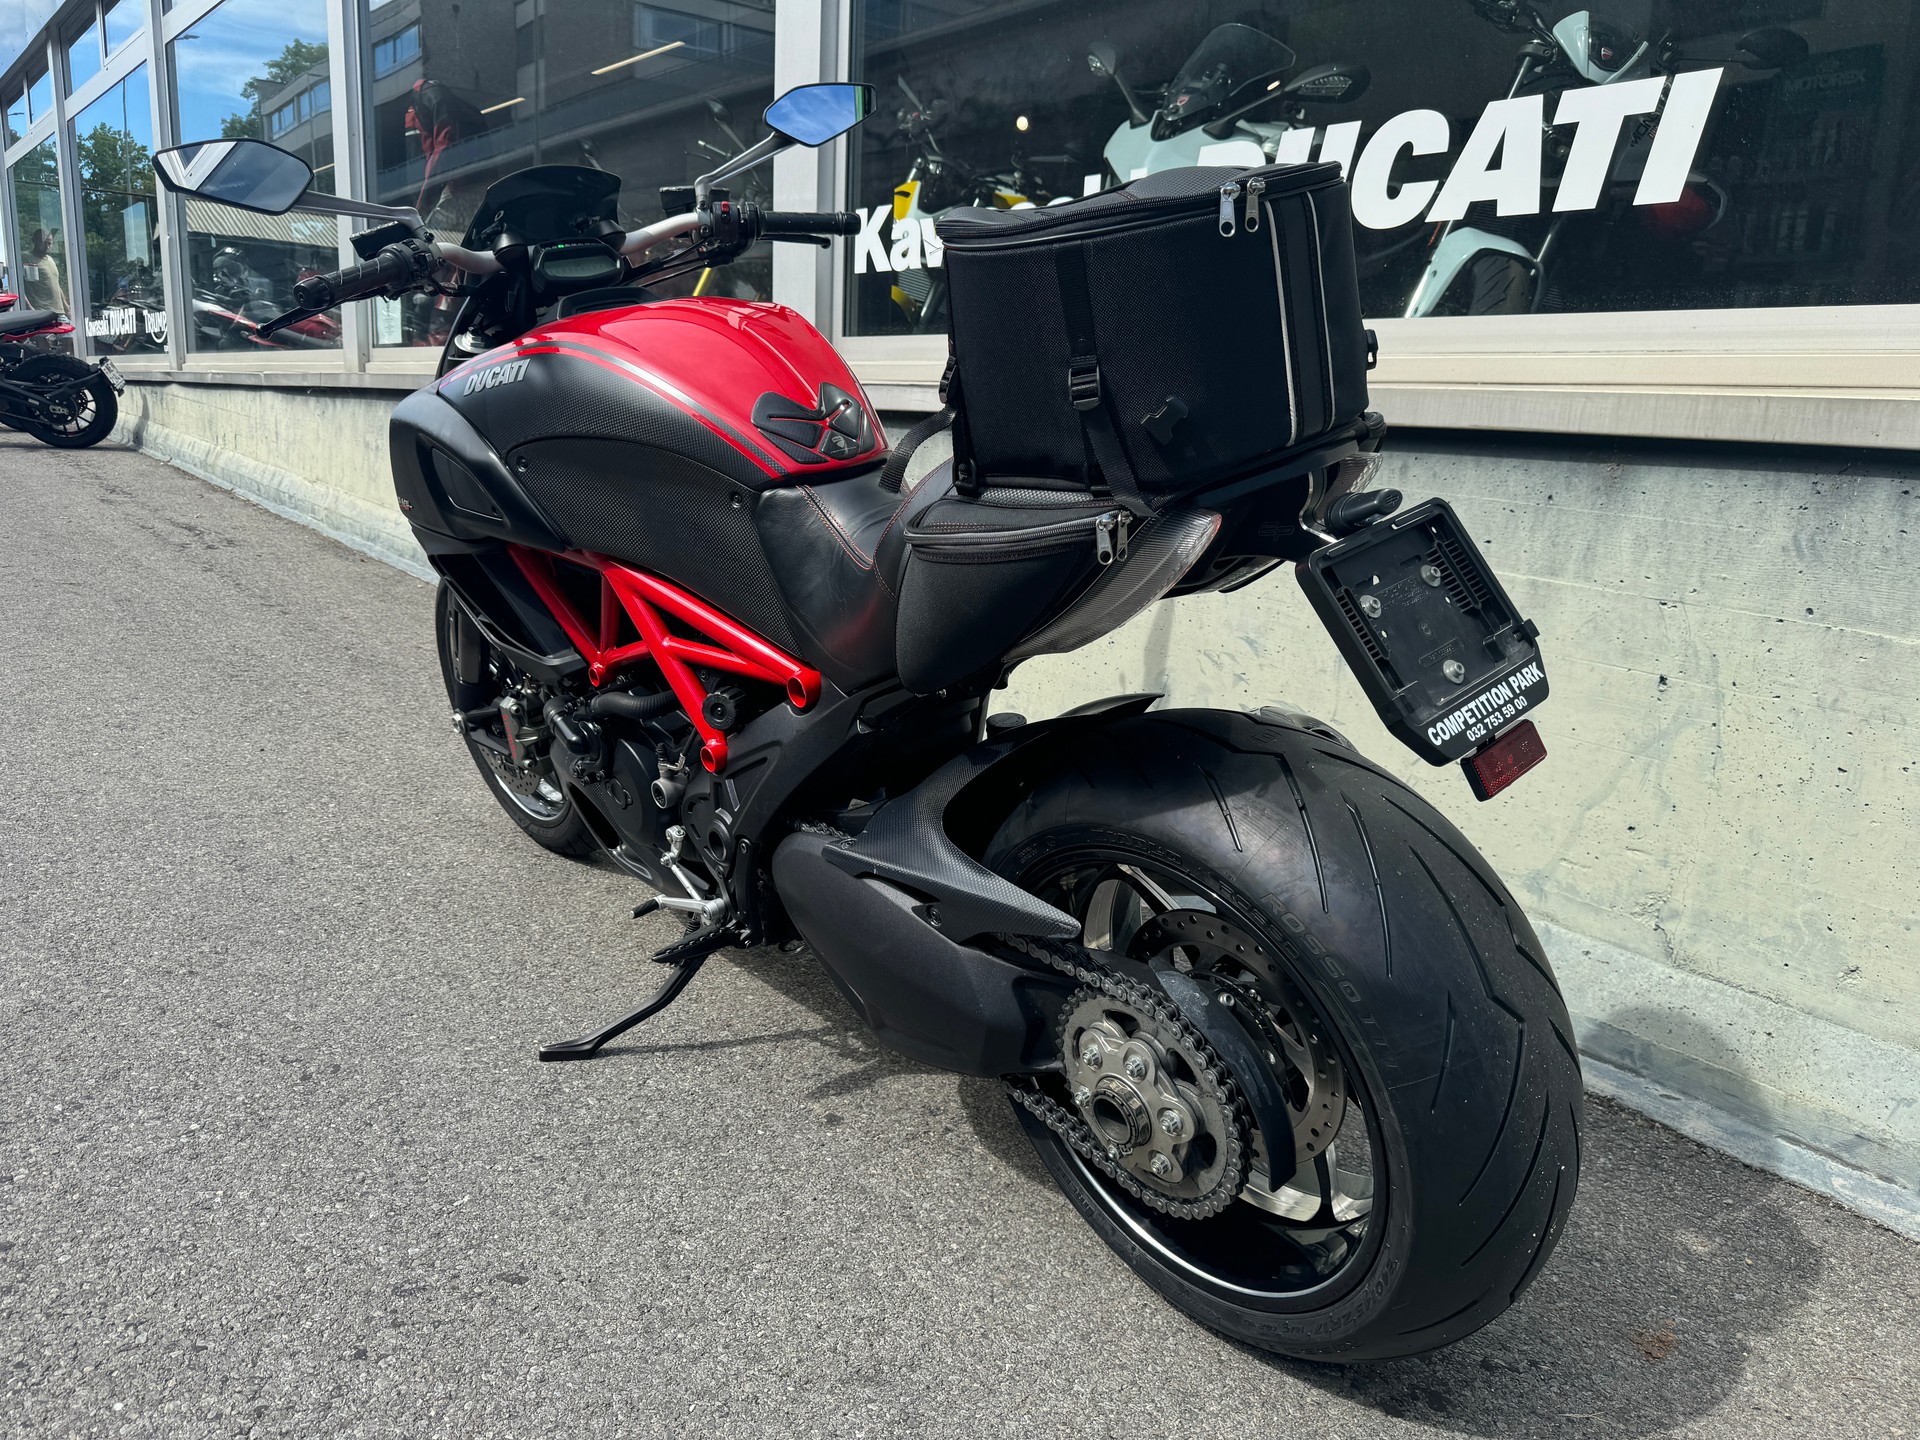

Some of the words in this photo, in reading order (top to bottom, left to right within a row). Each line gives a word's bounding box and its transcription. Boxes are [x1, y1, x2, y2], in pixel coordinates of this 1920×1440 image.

[1197, 67, 1725, 230] CATI
[109, 308, 137, 335] DUCATI
[143, 310, 168, 342] TRIUMP
[463, 359, 531, 396] DUCATI
[1427, 681, 1514, 746] COMPETITION
[1508, 661, 1545, 694] PARK
[1466, 723, 1487, 742] 032
[1484, 711, 1504, 730] 753
[1501, 704, 1516, 718] 59
[1514, 695, 1528, 710] 00
[1260, 891, 1362, 1003] ROSSO
